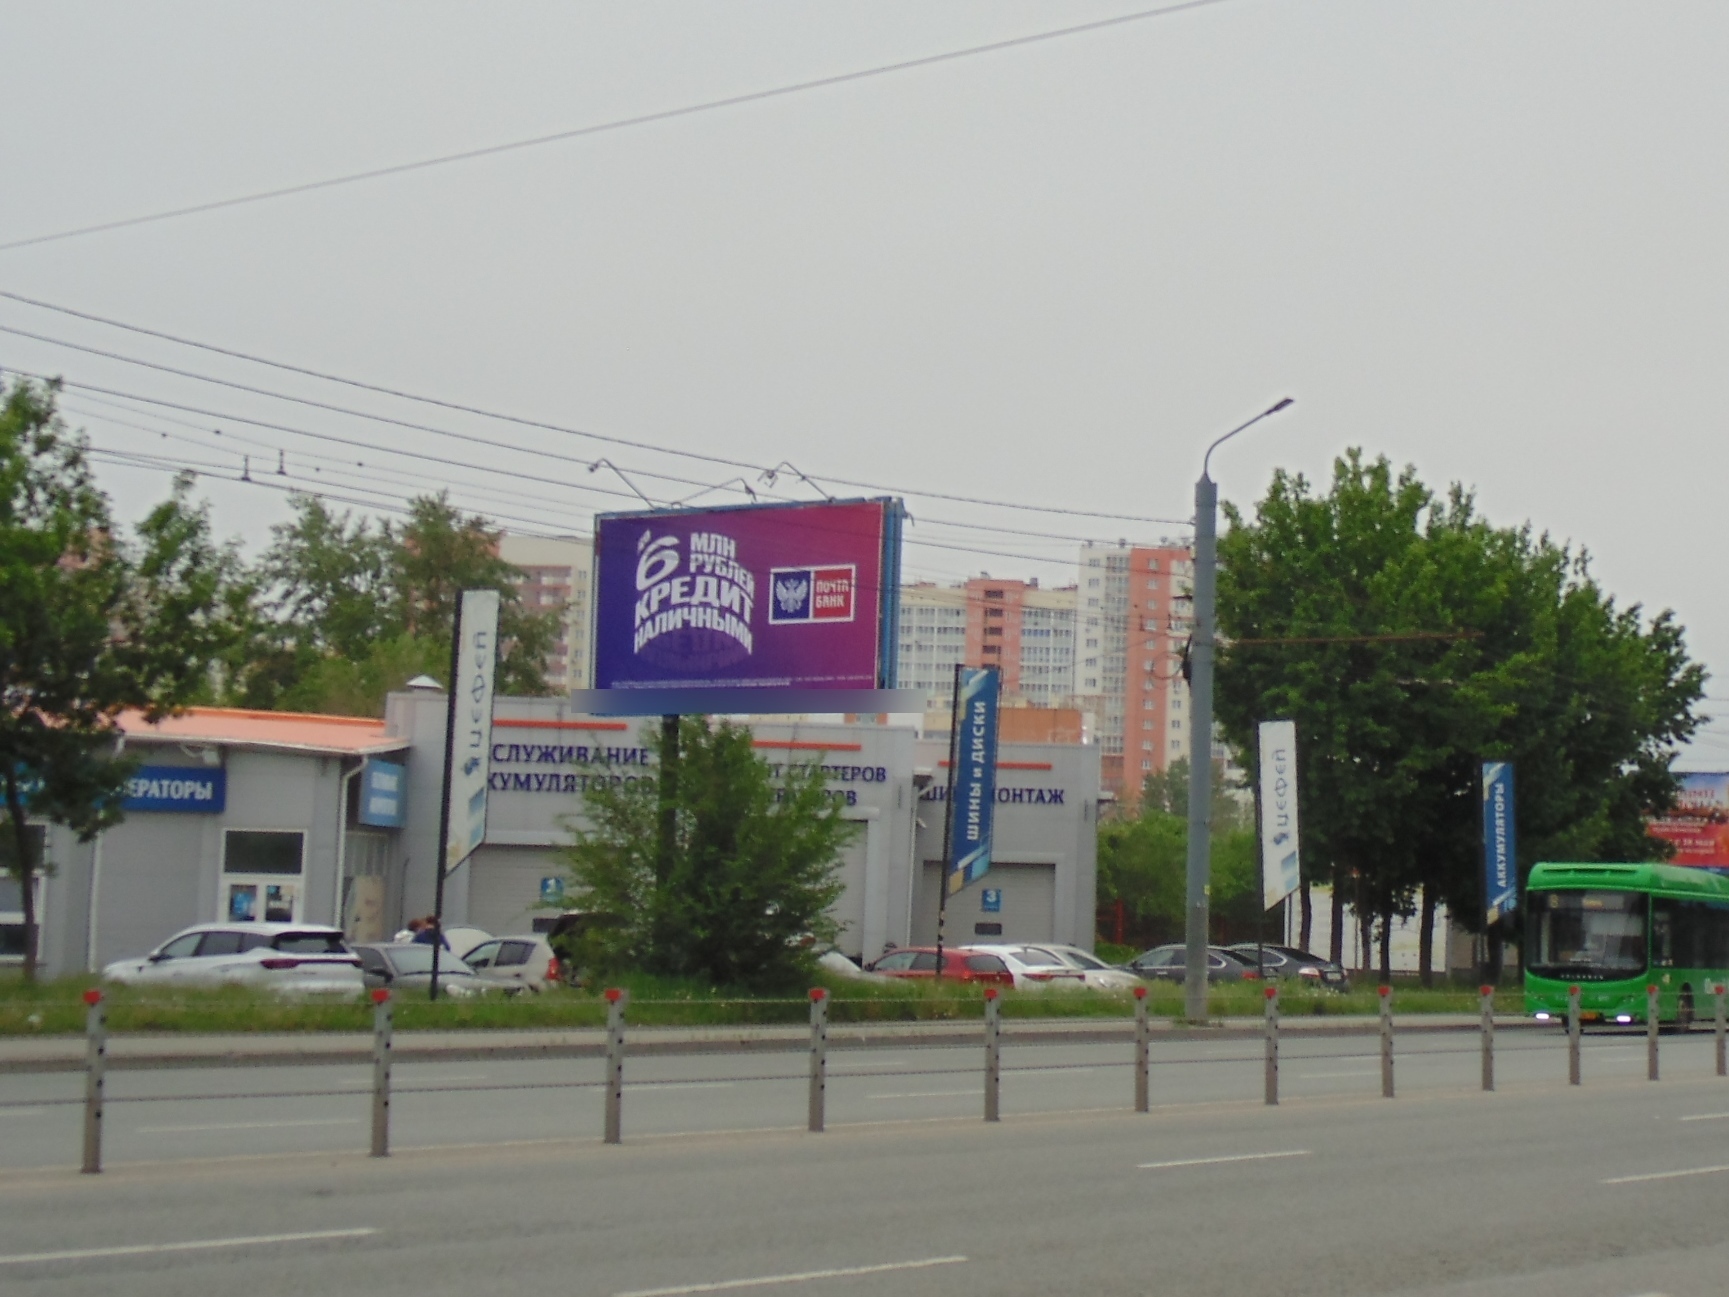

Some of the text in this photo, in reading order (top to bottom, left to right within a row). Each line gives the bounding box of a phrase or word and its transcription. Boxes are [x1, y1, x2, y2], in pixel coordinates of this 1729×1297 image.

[636, 535, 680, 591] 6
[690, 532, 736, 558] МЛН
[689, 552, 755, 599] РУБЛЕЙ
[635, 575, 754, 629] КРЕДИТ
[815, 594, 844, 609] БАНК
[816, 579, 849, 593] ПОЧТА
[633, 607, 753, 655] НАЛИЧНЫМИ
[492, 744, 649, 766] СЛУЖИВАНИЕ
[970, 701, 986, 764] ДИСКИ
[124, 778, 212, 801] ЕРАТОРЫ
[966, 782, 982, 841] ШИНЫ
[1494, 782, 1508, 888] АККУМУЛЯТОРЫ
